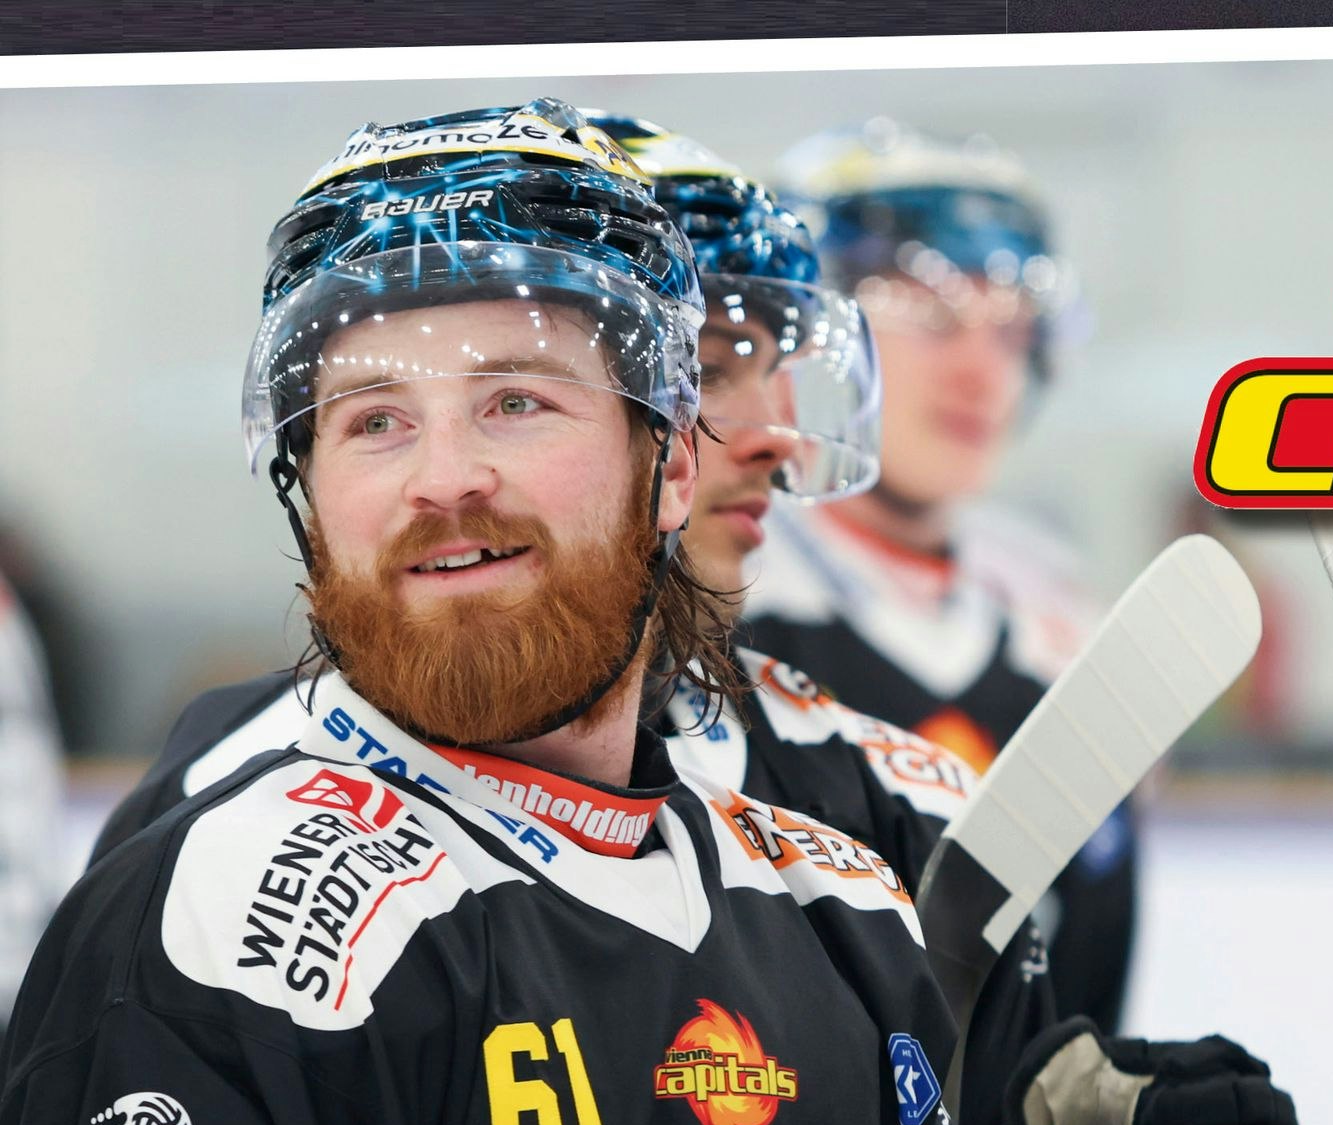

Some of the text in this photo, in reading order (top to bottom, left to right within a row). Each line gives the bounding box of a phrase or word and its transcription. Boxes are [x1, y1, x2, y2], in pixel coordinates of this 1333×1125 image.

[361, 189, 494, 221] BAUER
[463, 764, 650, 847] enholding
[237, 812, 359, 970] WIENER
[655, 1057, 799, 1102] capitals
